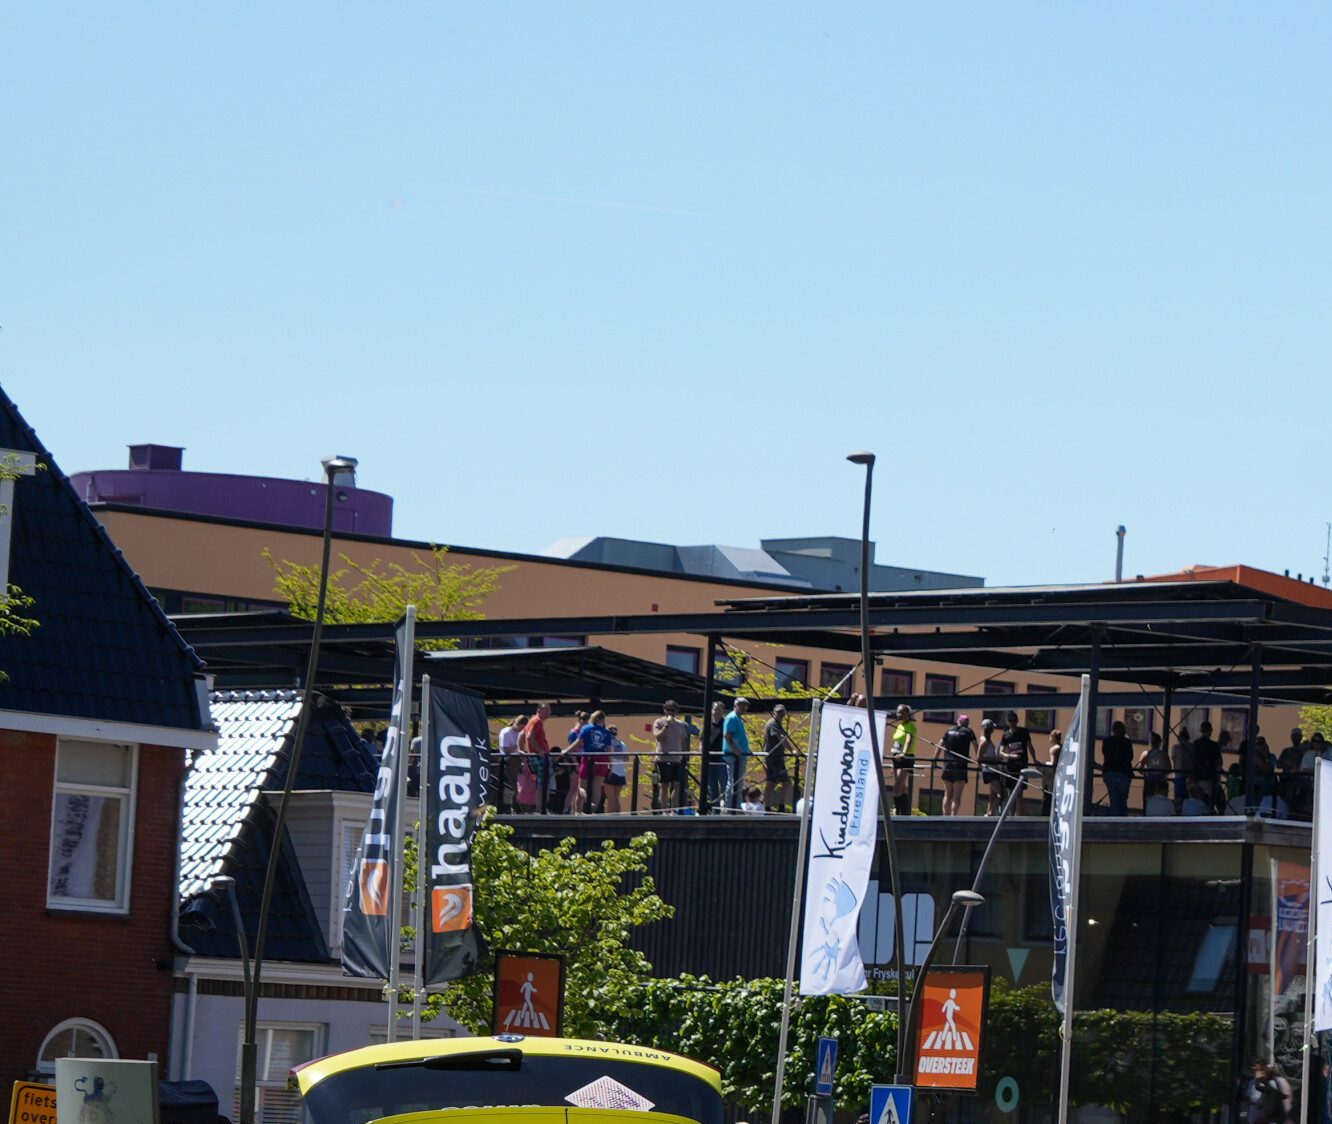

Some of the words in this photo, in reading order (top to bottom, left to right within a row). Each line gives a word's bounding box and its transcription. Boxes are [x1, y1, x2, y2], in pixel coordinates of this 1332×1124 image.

[432, 733, 473, 880] haan
[812, 718, 863, 859] Kinderopvang
[849, 757, 869, 830] Friesland
[564, 1044, 671, 1061] AMBULANCE
[918, 1056, 976, 1075] OVERSTEEK
